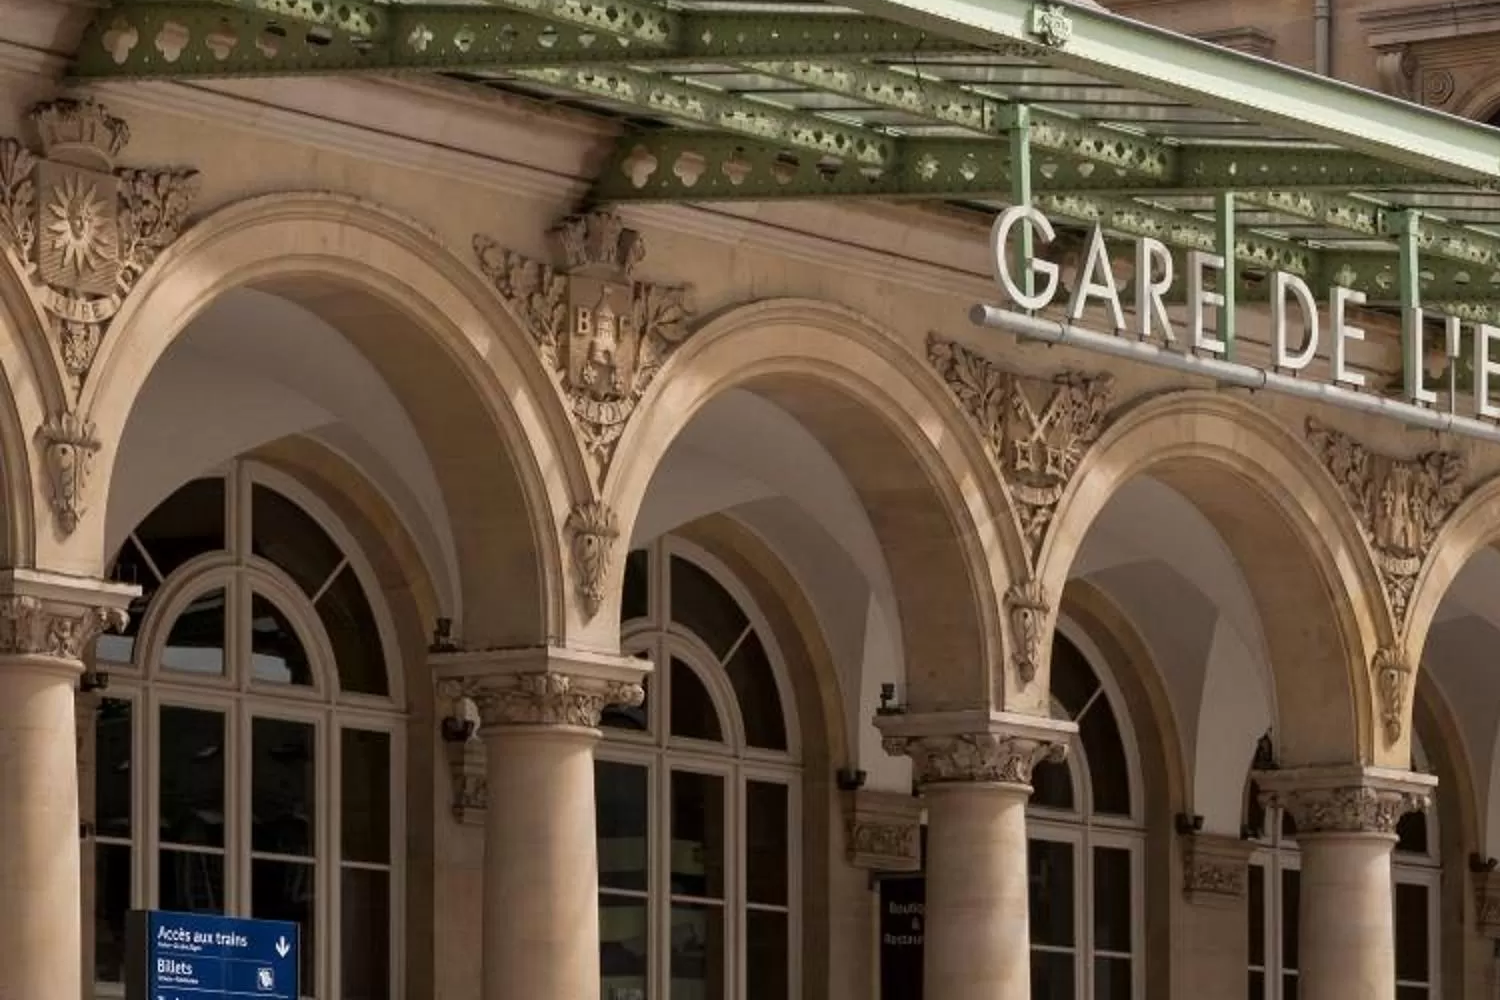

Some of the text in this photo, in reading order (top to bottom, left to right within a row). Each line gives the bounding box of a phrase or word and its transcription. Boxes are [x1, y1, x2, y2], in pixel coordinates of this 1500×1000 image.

[989, 205, 1226, 353] GARE
[1271, 271, 1367, 386] DE
[157, 925, 191, 942] Accès
[193, 931, 213, 944] aux
[215, 931, 248, 947] trains
[157, 958, 193, 975] Billets
